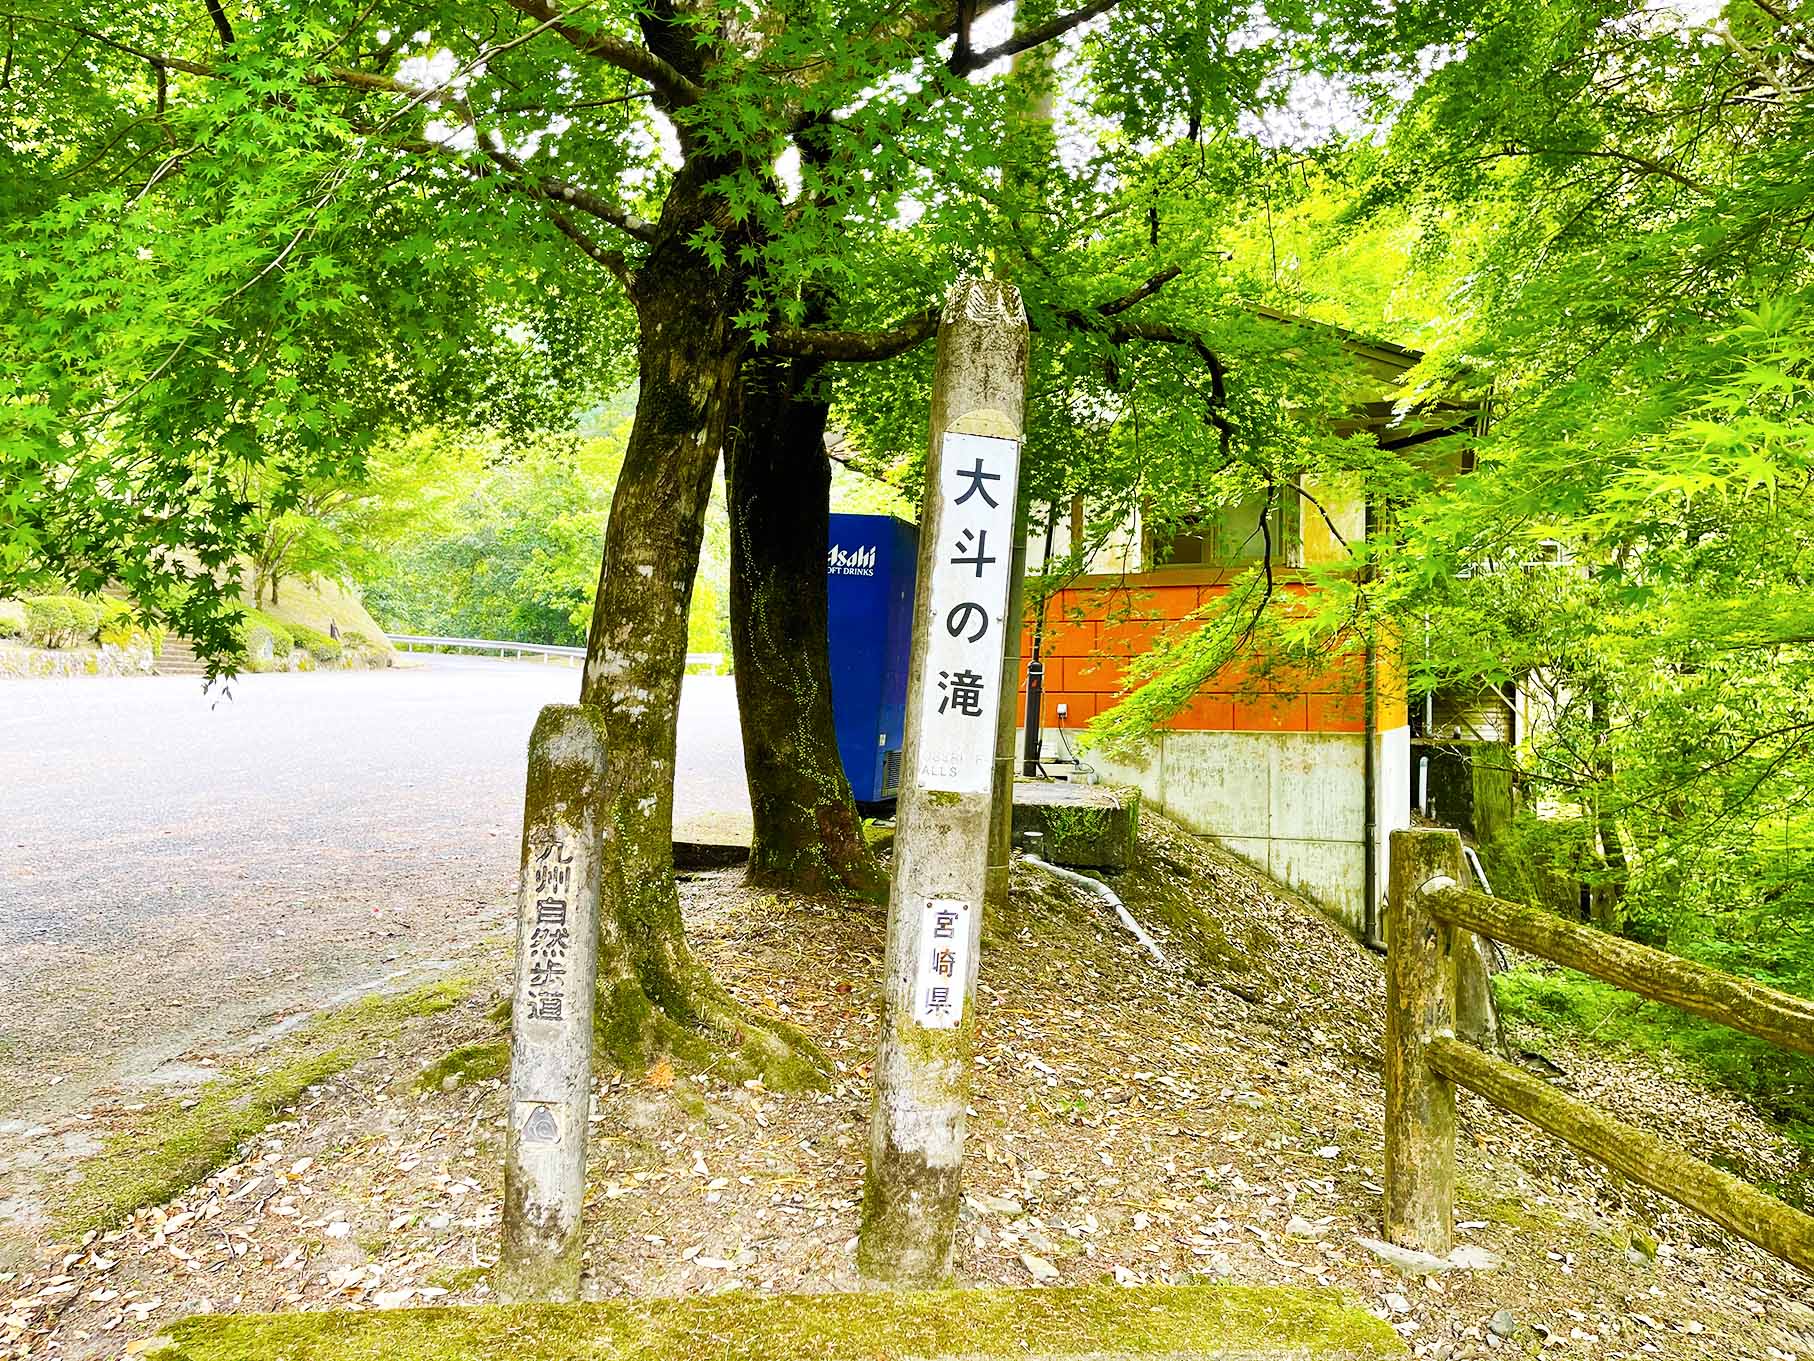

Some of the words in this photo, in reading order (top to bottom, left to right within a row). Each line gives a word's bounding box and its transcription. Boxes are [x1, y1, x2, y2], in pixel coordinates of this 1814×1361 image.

[827, 544, 876, 568] Asahi
[843, 567, 874, 576] DRINKS
[937, 458, 1001, 716] 大斗の滝
[527, 837, 573, 1021] 九州自然歩道
[926, 909, 959, 1016] 宮崎県
